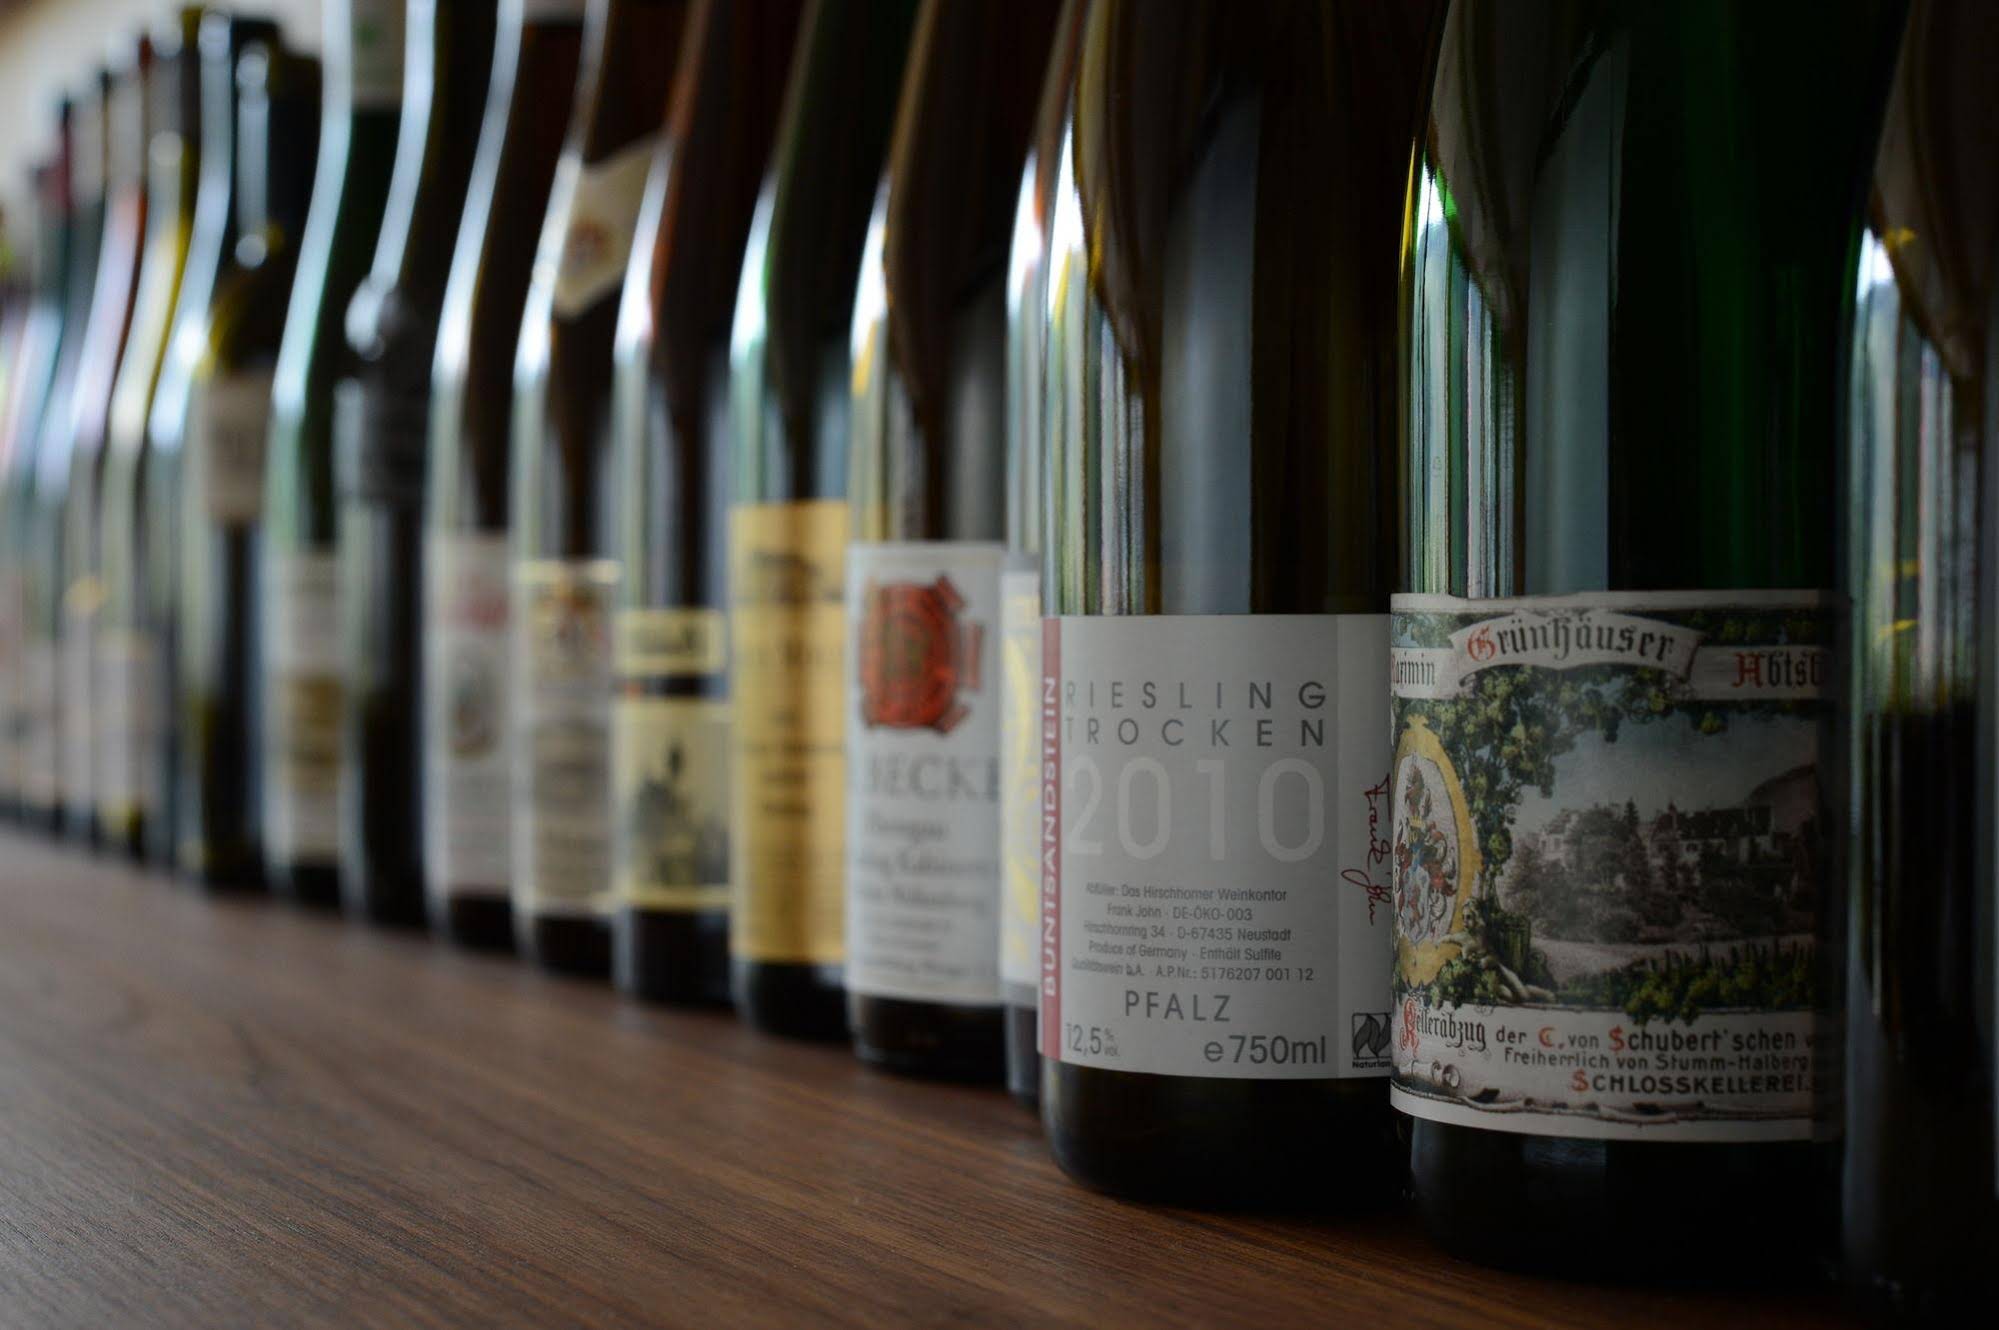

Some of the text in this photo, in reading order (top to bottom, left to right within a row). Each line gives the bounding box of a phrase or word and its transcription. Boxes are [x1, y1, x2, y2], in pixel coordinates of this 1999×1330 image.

[1467, 617, 1675, 663] Grünhäuser
[1067, 681, 1326, 710] RIESLING
[1066, 717, 1324, 747] TROCKEN
[1069, 755, 1326, 863] 2010
[1043, 677, 1058, 996] BUNTSANDSTEIN
[1121, 883, 1140, 898] Das
[1218, 888, 1288, 902] Weinkontor
[1107, 904, 1133, 917] Frank
[1135, 905, 1162, 919] John
[1150, 925, 1166, 938] 34
[1177, 926, 1233, 941] D-67435
[1237, 928, 1292, 942] Neustadt
[1088, 940, 1124, 954] Produce
[1126, 944, 1136, 956] of
[1138, 944, 1187, 961] Germany
[1244, 947, 1282, 961] Sulfite
[1201, 966, 1261, 982] 5176207
[1266, 967, 1291, 982] 001
[1297, 967, 1315, 982] 12
[1125, 990, 1232, 1022] PFALZ
[1066, 1022, 1102, 1057] 12,5
[1495, 1023, 1527, 1044] der
[1568, 1033, 1599, 1049] von
[1608, 1025, 1796, 1052] Schubert'schen
[1505, 1046, 1610, 1069] Freiherrlich
[1615, 1055, 1648, 1070] von
